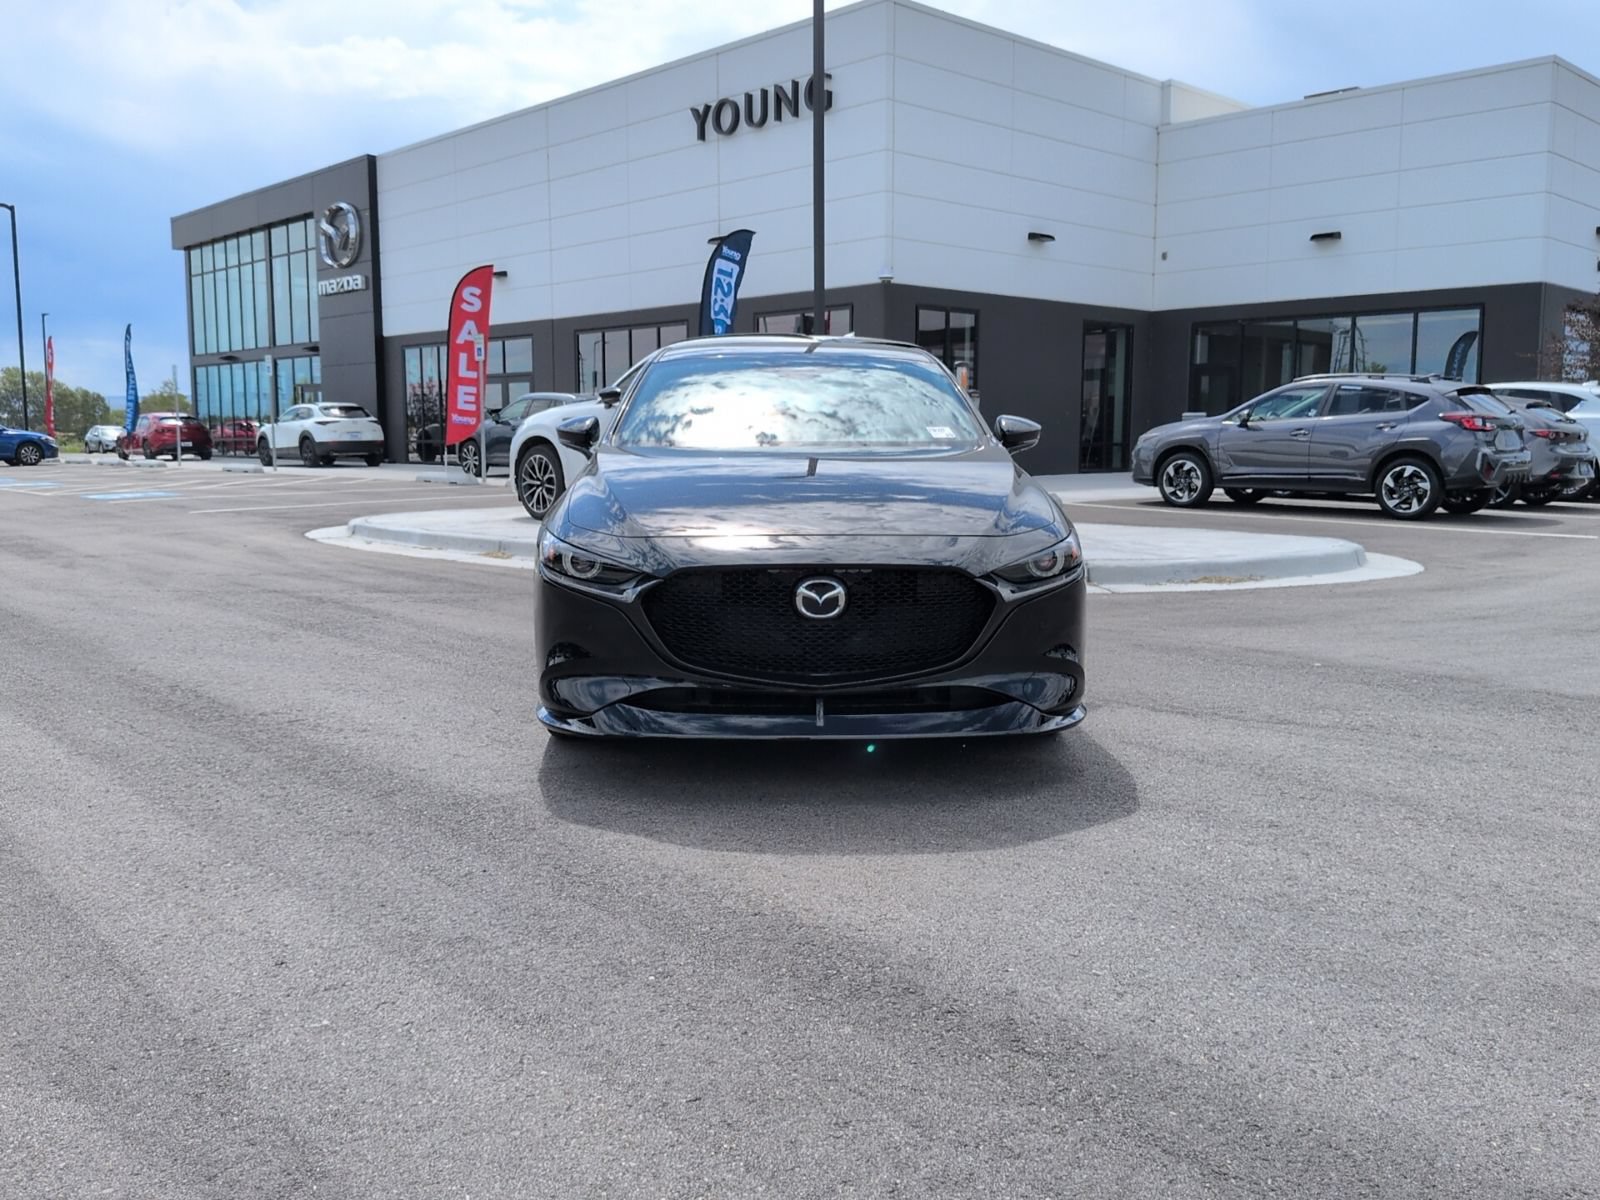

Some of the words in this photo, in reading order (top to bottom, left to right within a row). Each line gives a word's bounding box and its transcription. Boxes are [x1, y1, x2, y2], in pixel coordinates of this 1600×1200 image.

[690, 73, 833, 142] YOUNG
[318, 275, 363, 296] mazda
[456, 286, 482, 411] SALE
